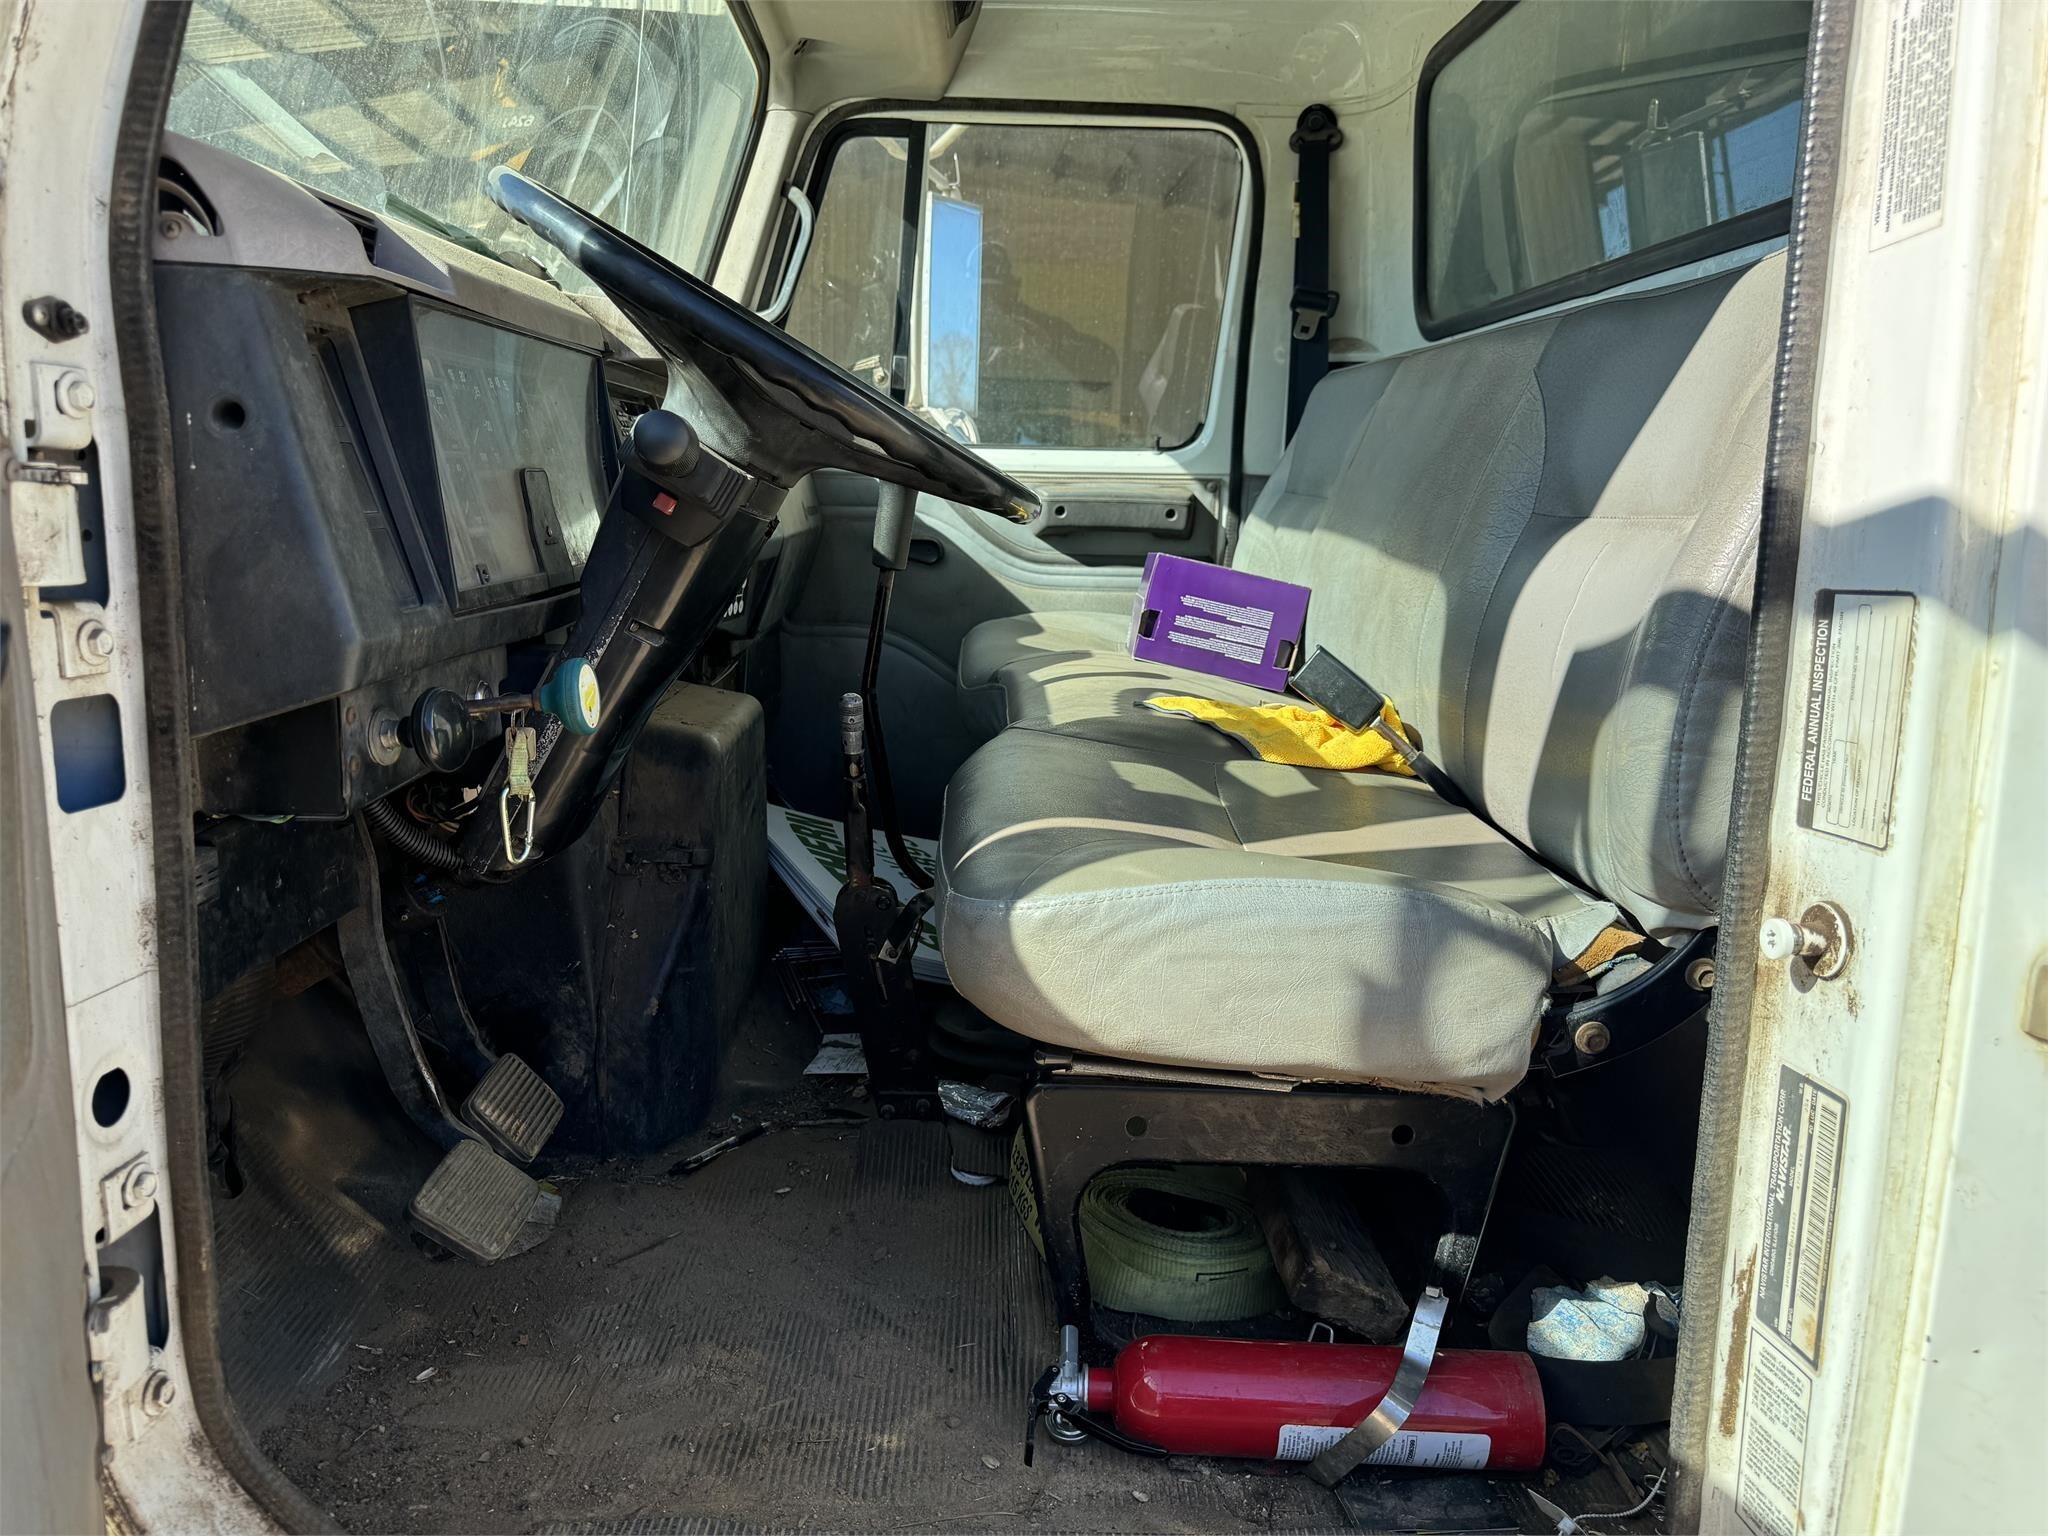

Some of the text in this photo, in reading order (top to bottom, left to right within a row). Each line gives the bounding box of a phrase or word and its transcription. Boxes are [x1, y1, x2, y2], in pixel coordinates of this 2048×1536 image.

[1801, 619, 1829, 801] FEDERAL ANNUAL INSPECTION
[1769, 1115, 1783, 1190] TRANSPORTATION
[1776, 1125, 1792, 1205] NAVISTAR
[1016, 1191, 1033, 1222] KGS
[1762, 1192, 1776, 1258] INTERNATIONAL
[1759, 1257, 1769, 1299] NAVISTAR
